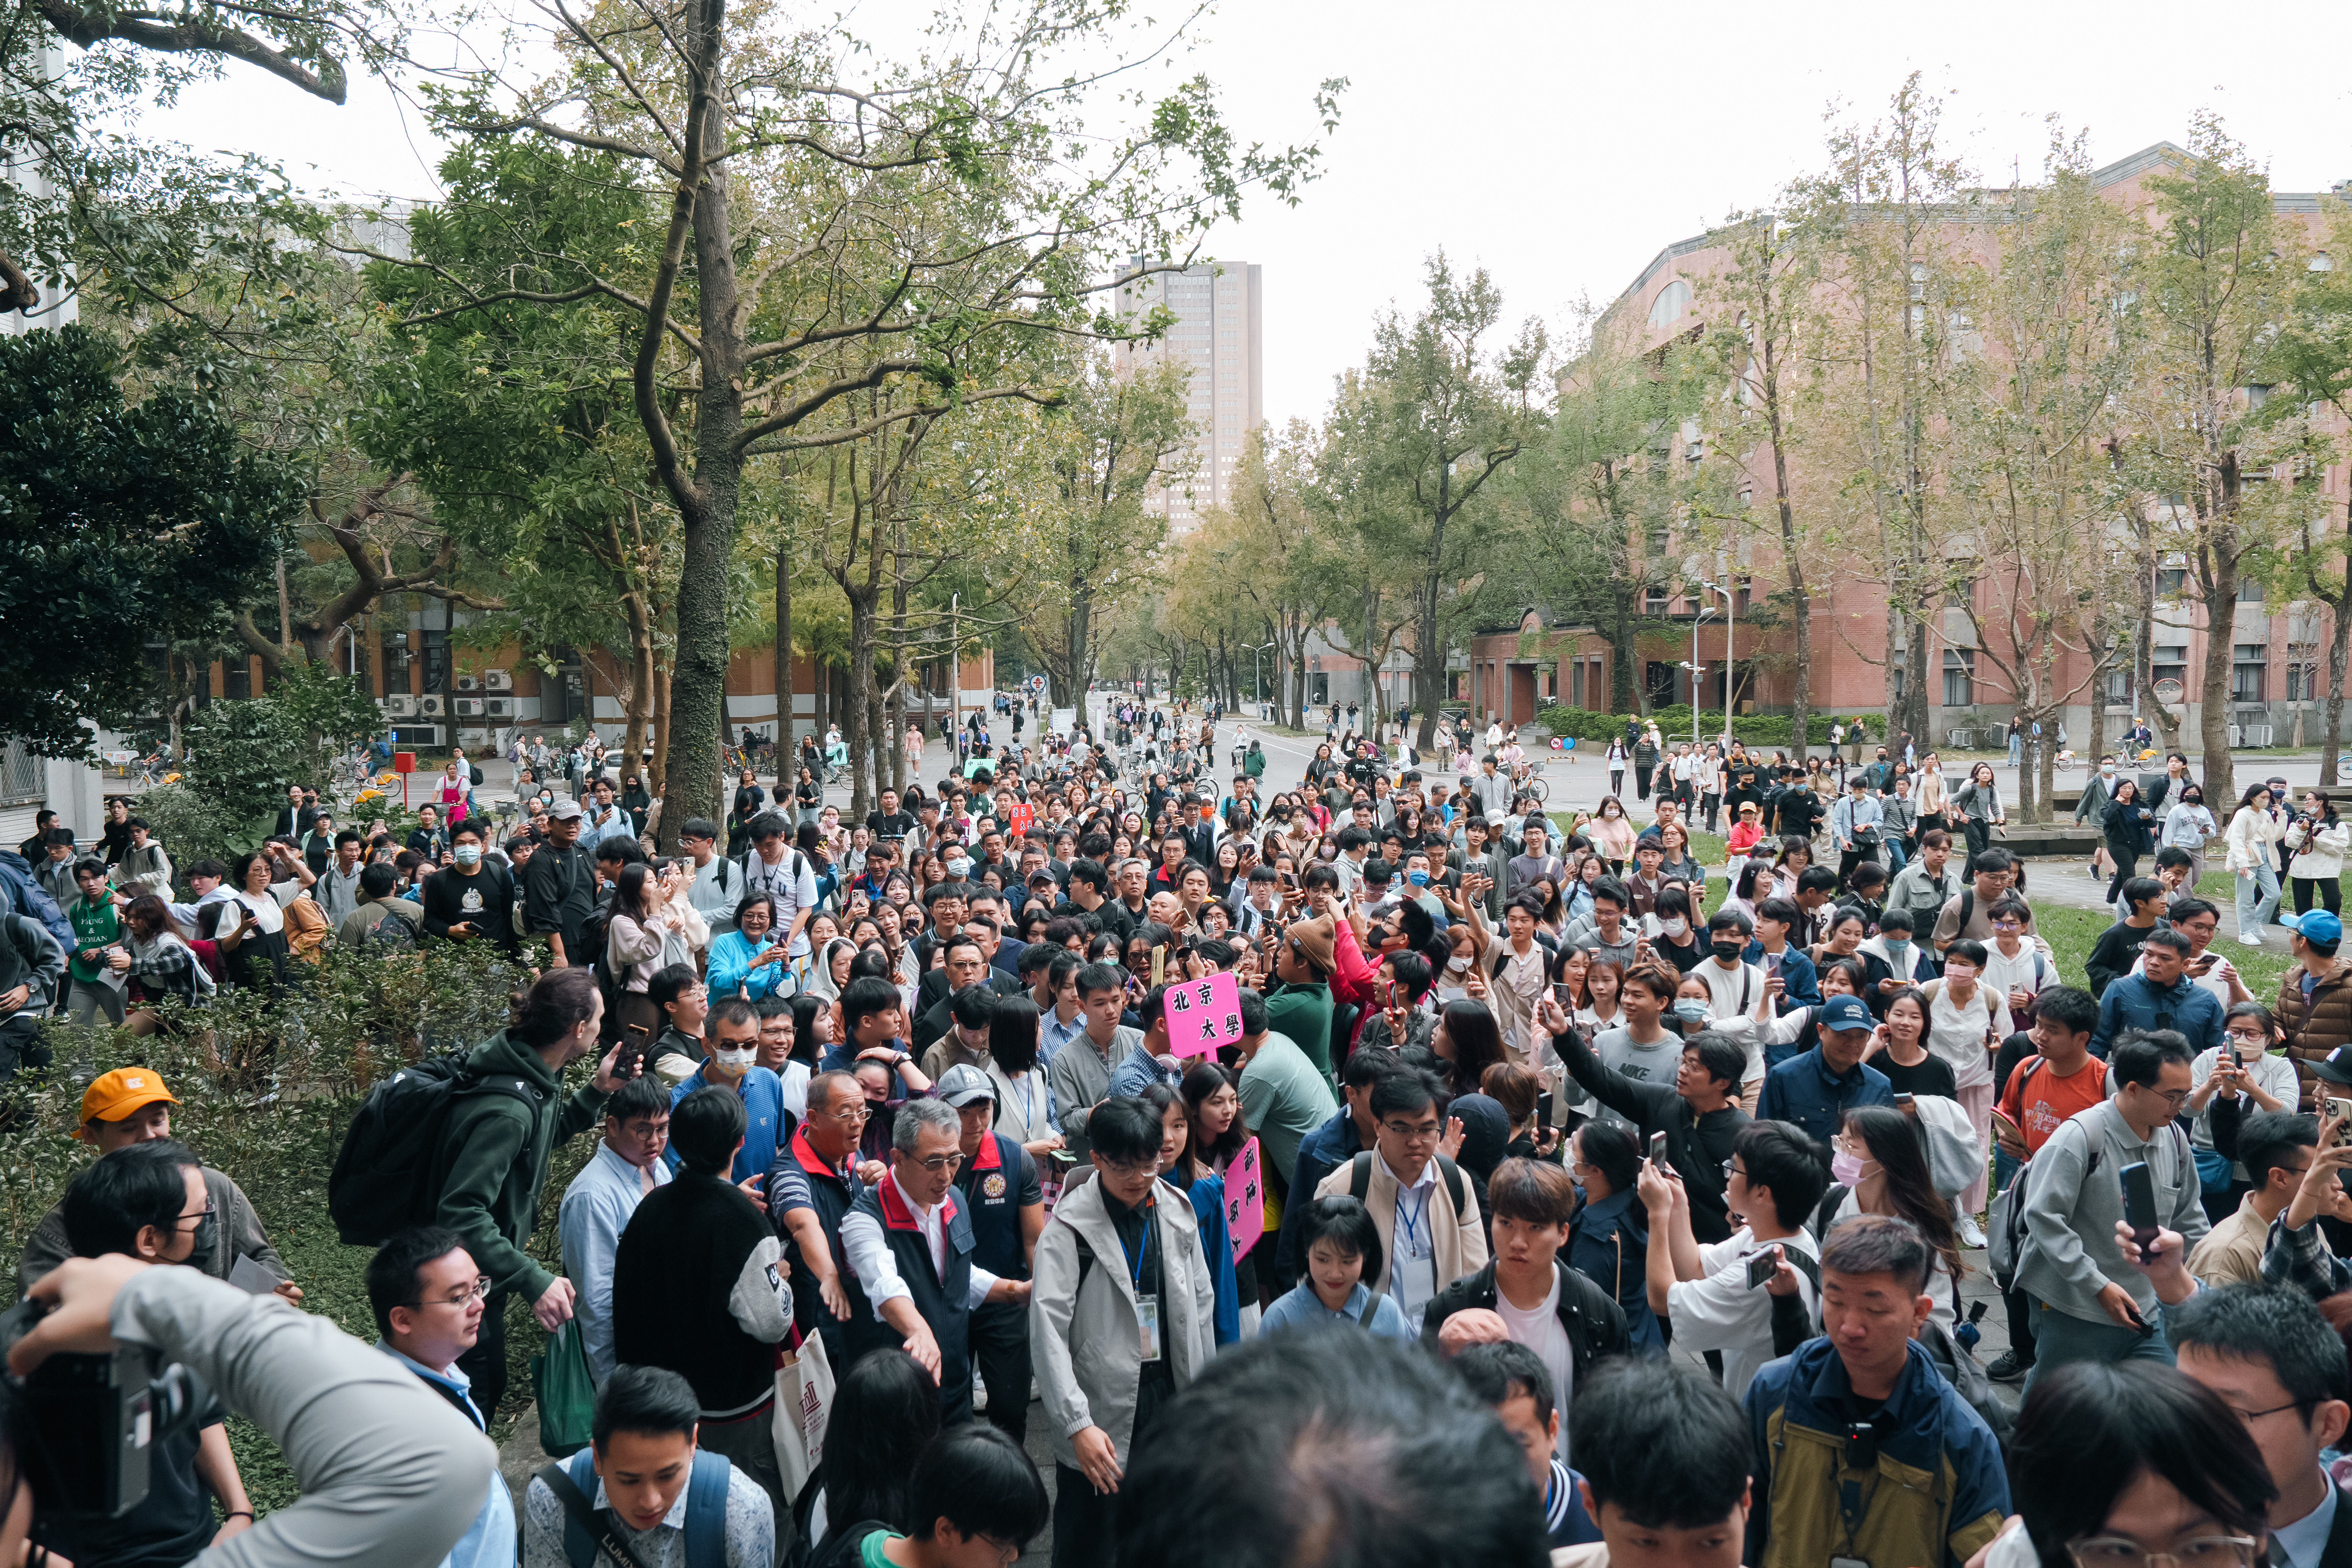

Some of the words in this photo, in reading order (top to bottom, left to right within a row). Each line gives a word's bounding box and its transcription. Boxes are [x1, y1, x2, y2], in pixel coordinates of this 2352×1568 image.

[1012, 805, 1026, 817] 浙江
[1172, 982, 1213, 1012] 北京
[1199, 1013, 1240, 1041] 大學
[1618, 1063, 1651, 1081] NIKE
[1244, 1144, 1258, 1209] 福建
